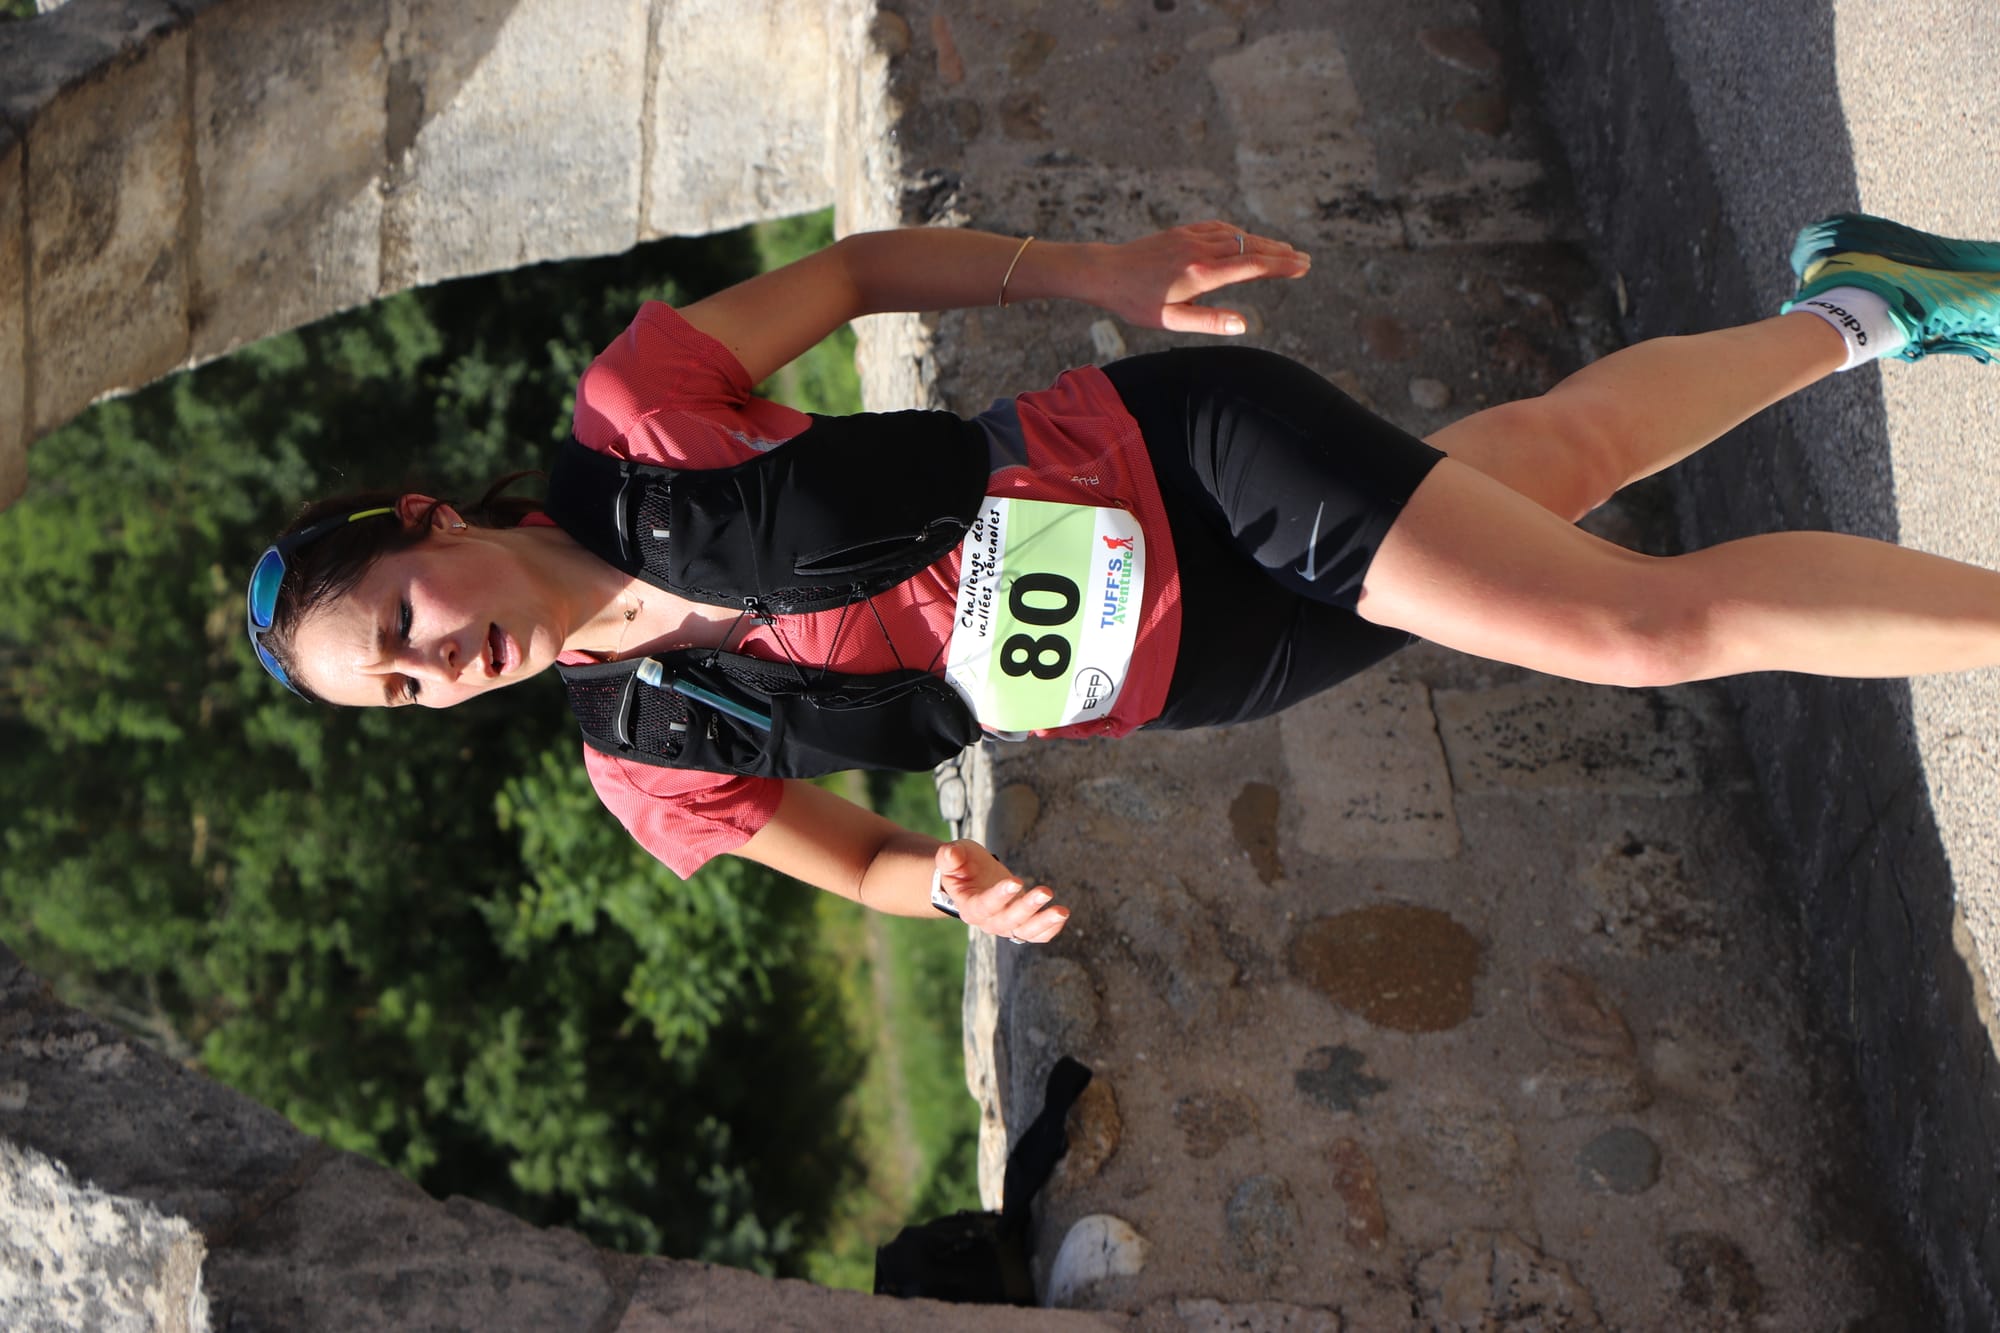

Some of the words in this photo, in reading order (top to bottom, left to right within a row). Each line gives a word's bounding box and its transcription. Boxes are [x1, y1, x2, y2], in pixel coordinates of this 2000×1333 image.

[962, 553, 985, 628] Challenge
[974, 517, 985, 543] des
[978, 587, 993, 637] vallées
[986, 509, 1000, 577] cévenoles
[1101, 558, 1122, 629] TUFF'S
[1113, 551, 1133, 624] Aventure
[1000, 573, 1081, 680] 80
[1083, 674, 1102, 709] BFP
